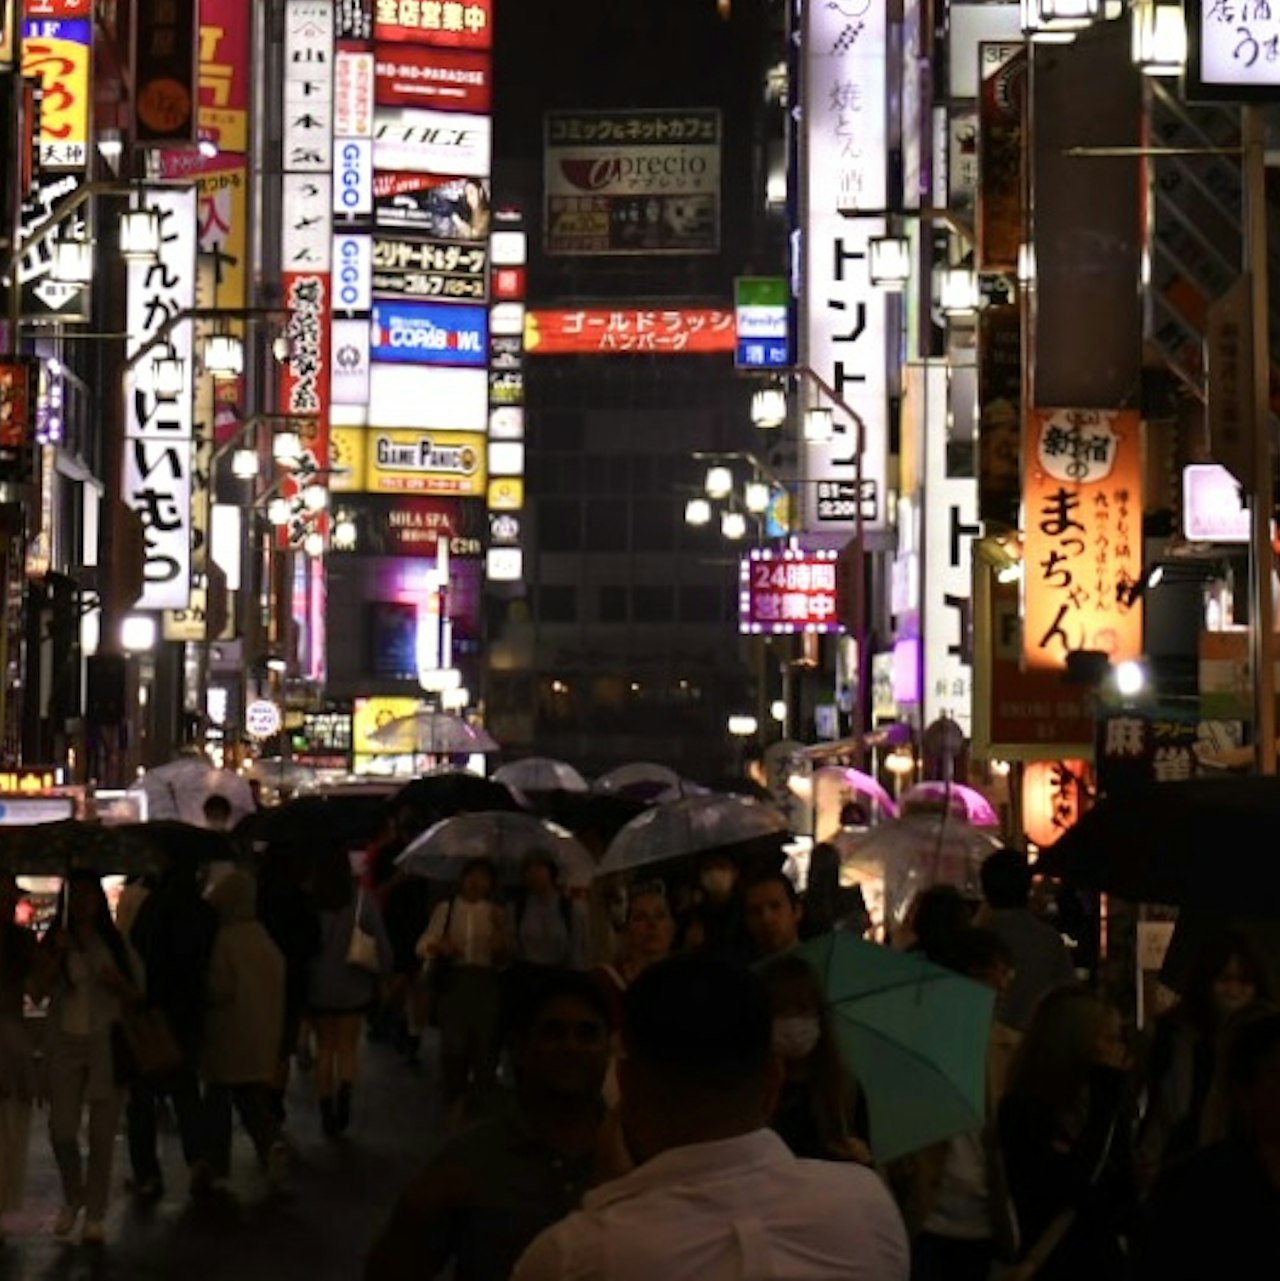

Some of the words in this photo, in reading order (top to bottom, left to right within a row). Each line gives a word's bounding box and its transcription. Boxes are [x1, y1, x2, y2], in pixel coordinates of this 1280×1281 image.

[342, 143, 361, 207] GiGO
[340, 239, 360, 304] GiGO
[562, 311, 736, 334] ゴールドラッシ
[599, 331, 689, 352] ハンバーグ
[755, 563, 836, 590] 24時間
[1039, 487, 1090, 651] まっちゃん
[755, 593, 836, 620] 営業中
